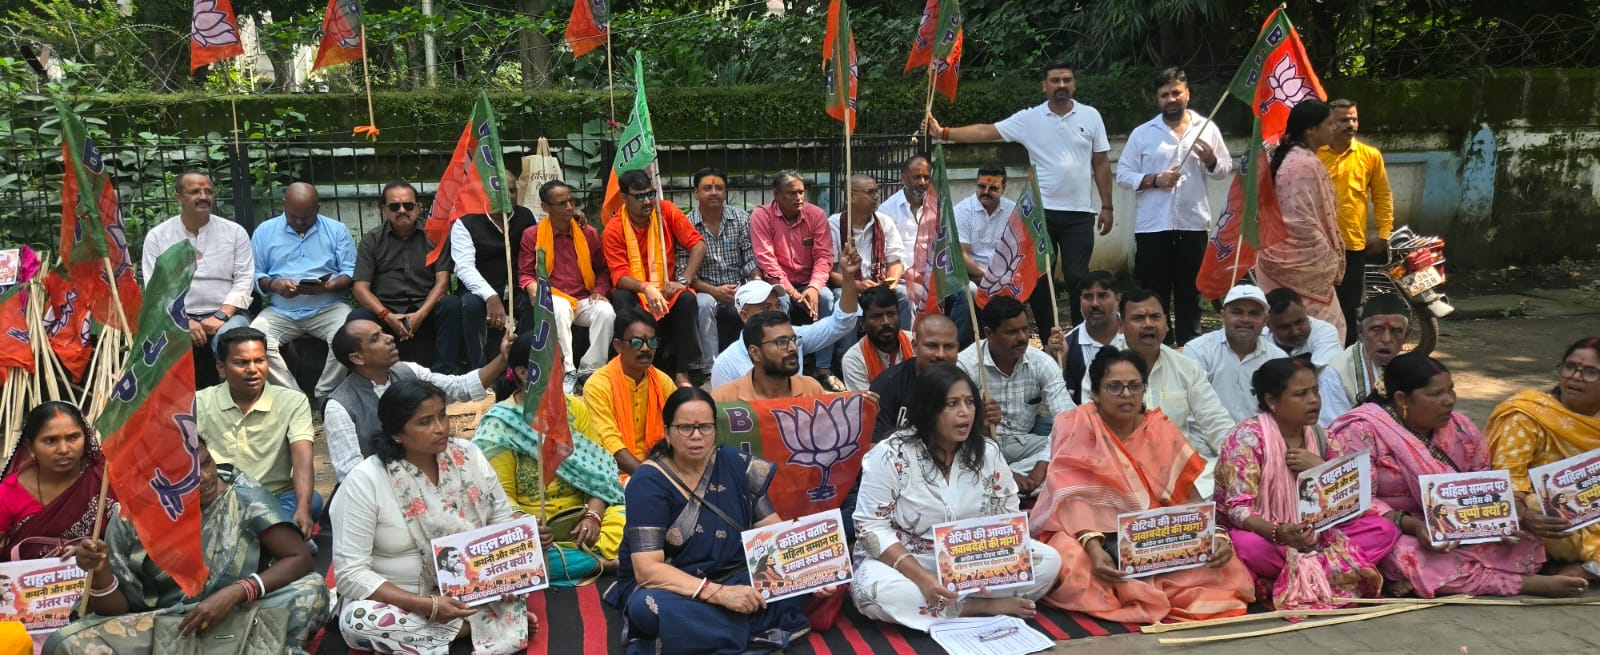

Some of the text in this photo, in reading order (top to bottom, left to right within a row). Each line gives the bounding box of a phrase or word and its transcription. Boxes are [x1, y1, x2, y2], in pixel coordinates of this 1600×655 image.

[1441, 481, 1505, 498] महिला सम्मान पर
[1457, 505, 1480, 524] चुप्पी
[1132, 519, 1157, 533] बेटियों
[1158, 515, 1170, 526] की
[1132, 526, 1170, 541] जवाबदेही
[1170, 523, 1183, 534] की
[469, 527, 529, 556] राहुल गांधी,
[779, 532, 807, 549] कांग्रेस
[948, 529, 973, 544] बेटियों
[973, 528, 986, 540] की
[473, 553, 495, 568] कथनी
[495, 550, 508, 561] और
[509, 544, 527, 555] करनी
[782, 533, 840, 561] महिला सम्मान पर
[949, 541, 987, 557] जवाबदेही
[988, 537, 1000, 551] की
[485, 562, 508, 577] अंतर
[24, 571, 56, 587] राहुल
[36, 596, 61, 609] अंतर
